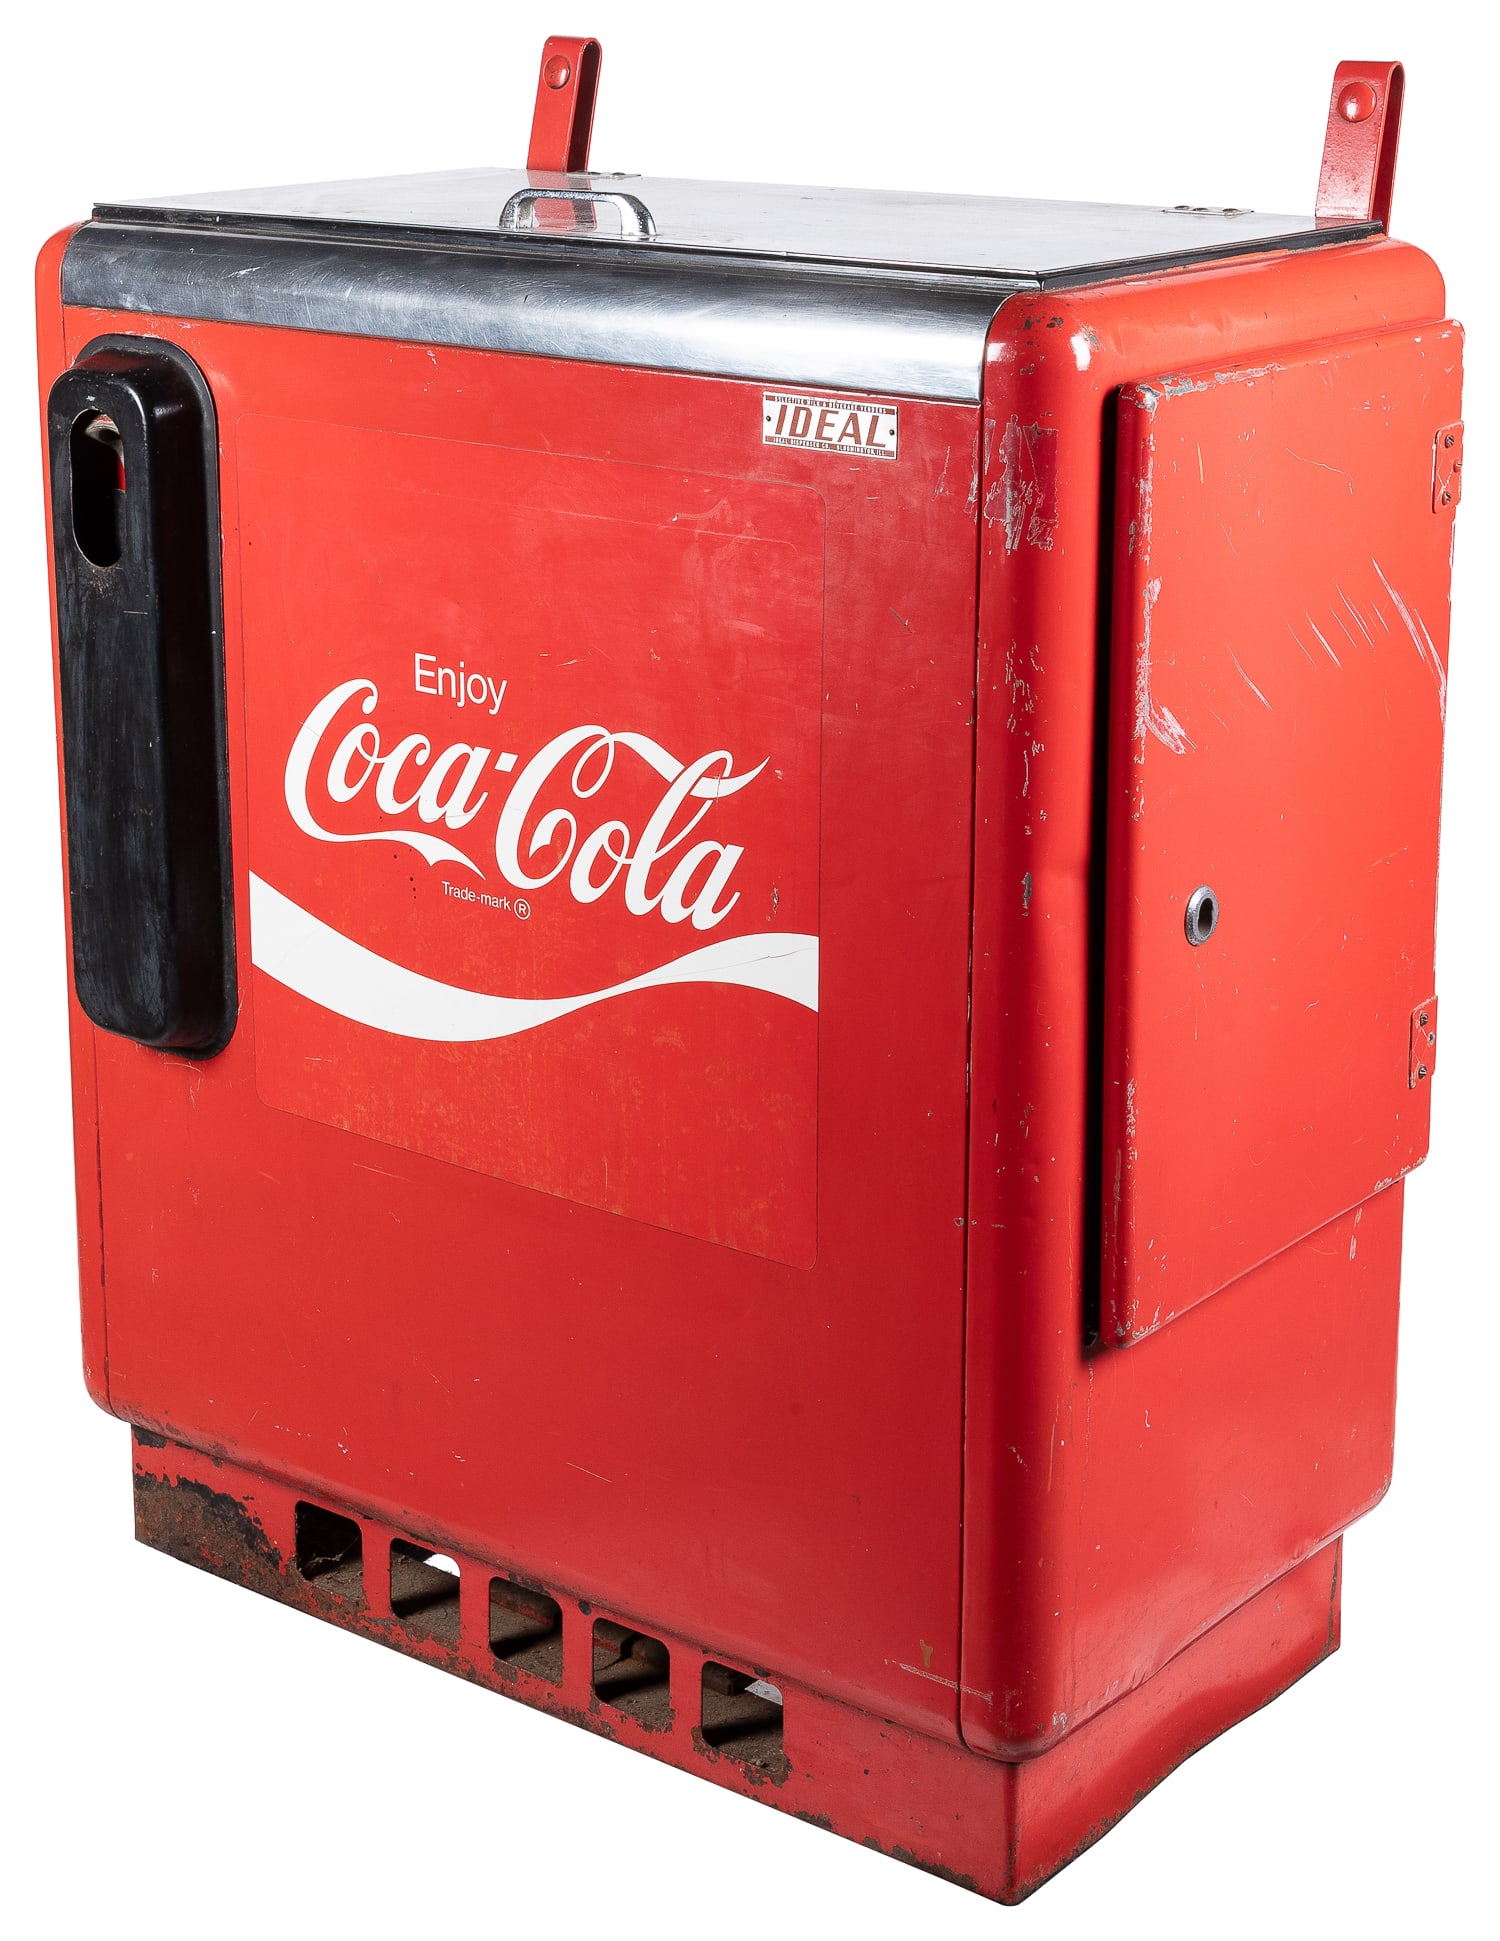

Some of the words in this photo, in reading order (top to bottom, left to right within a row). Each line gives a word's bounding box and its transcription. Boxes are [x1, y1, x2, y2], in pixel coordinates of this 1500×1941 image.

[775, 404, 886, 448] IDEAL
[414, 652, 508, 716] Enjoy
[284, 678, 770, 931] Coca-Cola
[441, 880, 512, 911] Trade-mark
